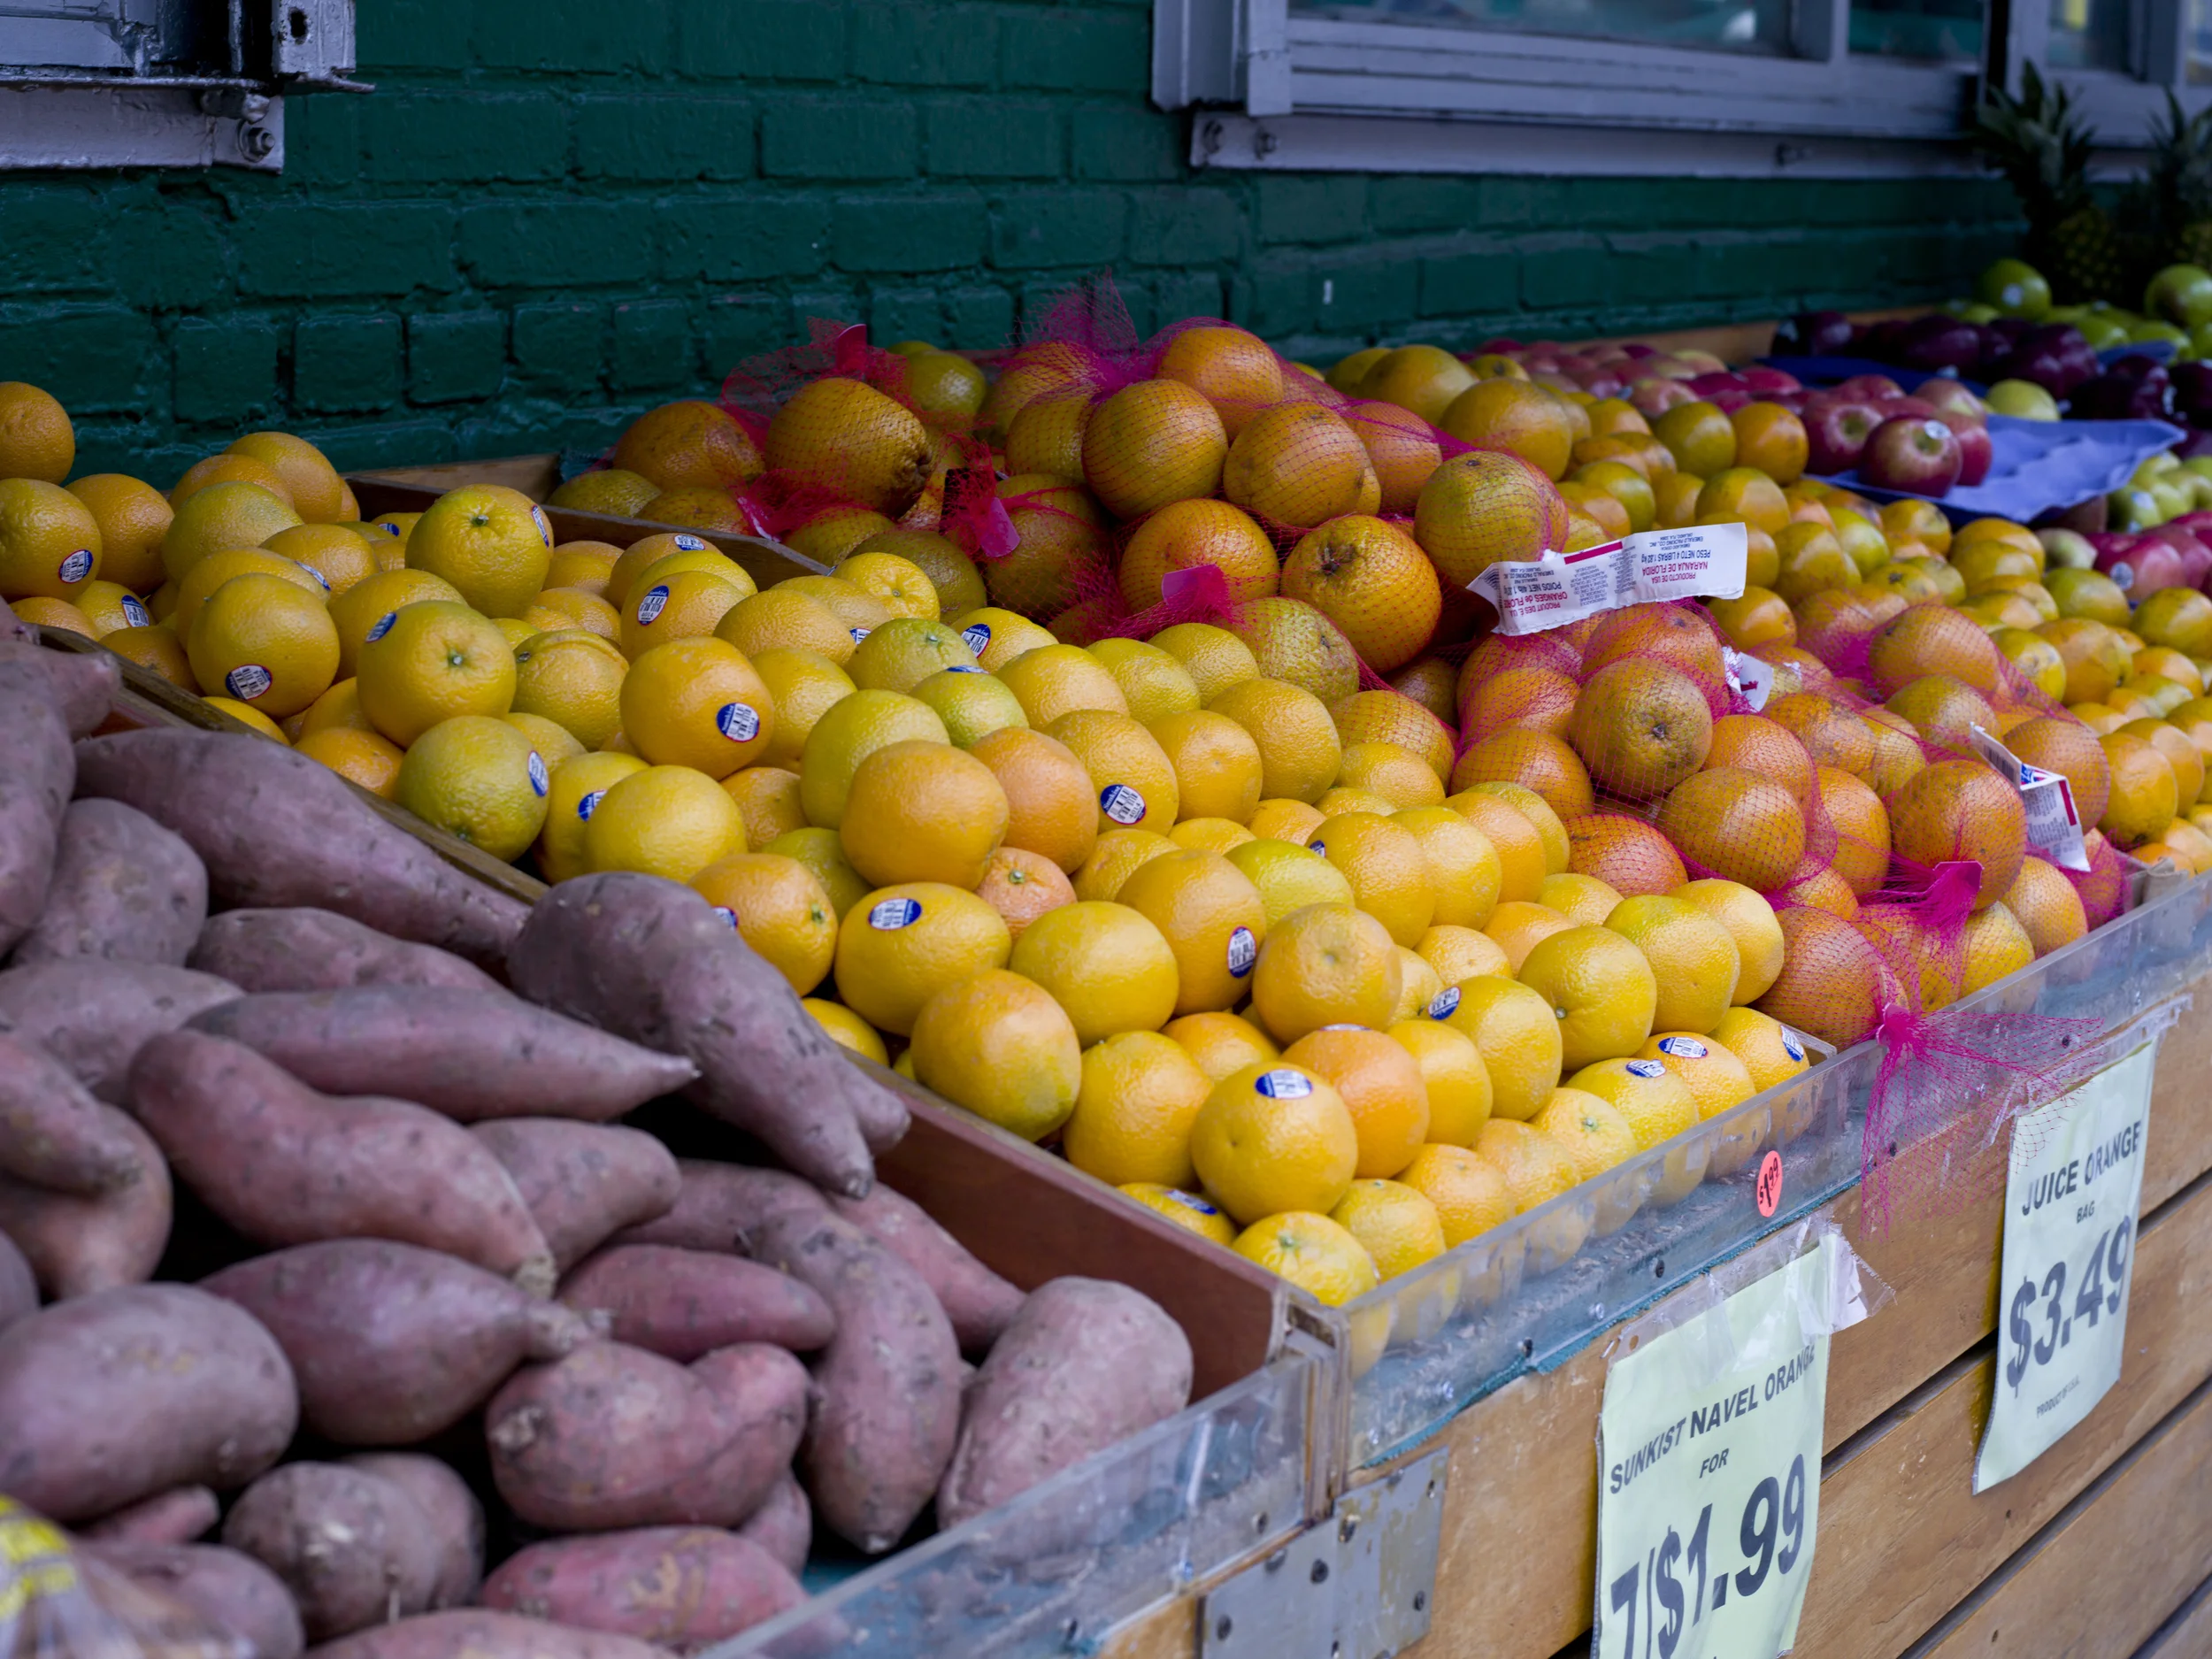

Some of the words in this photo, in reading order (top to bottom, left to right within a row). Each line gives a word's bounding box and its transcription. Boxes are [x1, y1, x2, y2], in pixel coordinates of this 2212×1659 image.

[1657, 552, 1676, 562] LIBRAS
[1681, 549, 1696, 559] NETO
[1696, 549, 1711, 558] PESO
[1642, 565, 1667, 576] FLORIDA
[1668, 564, 1677, 572] DE
[1678, 561, 1709, 572] NARANJA
[1669, 572, 1696, 581] PRODUCTO
[1541, 581, 1562, 591] POIDS
[1525, 595, 1533, 603] de
[1534, 591, 1568, 603] ORANGES
[1525, 606, 1536, 615] DES
[1537, 602, 1561, 612] PRODUIT
[1102, 786, 1121, 810] Sunkist
[1129, 803, 1141, 818] 4014
[2022, 1159, 2079, 1216] JUICE
[2085, 1120, 2141, 1186] ORANGE
[2077, 1200, 2095, 1224] BAG
[2007, 1215, 2131, 1399] $3.49
[1609, 1417, 1687, 1494] SUNKIST
[1690, 1384, 1759, 1439] NAVEL
[1699, 1448, 1730, 1479] FOR
[1610, 1454, 1805, 1659] 7/$1.99
